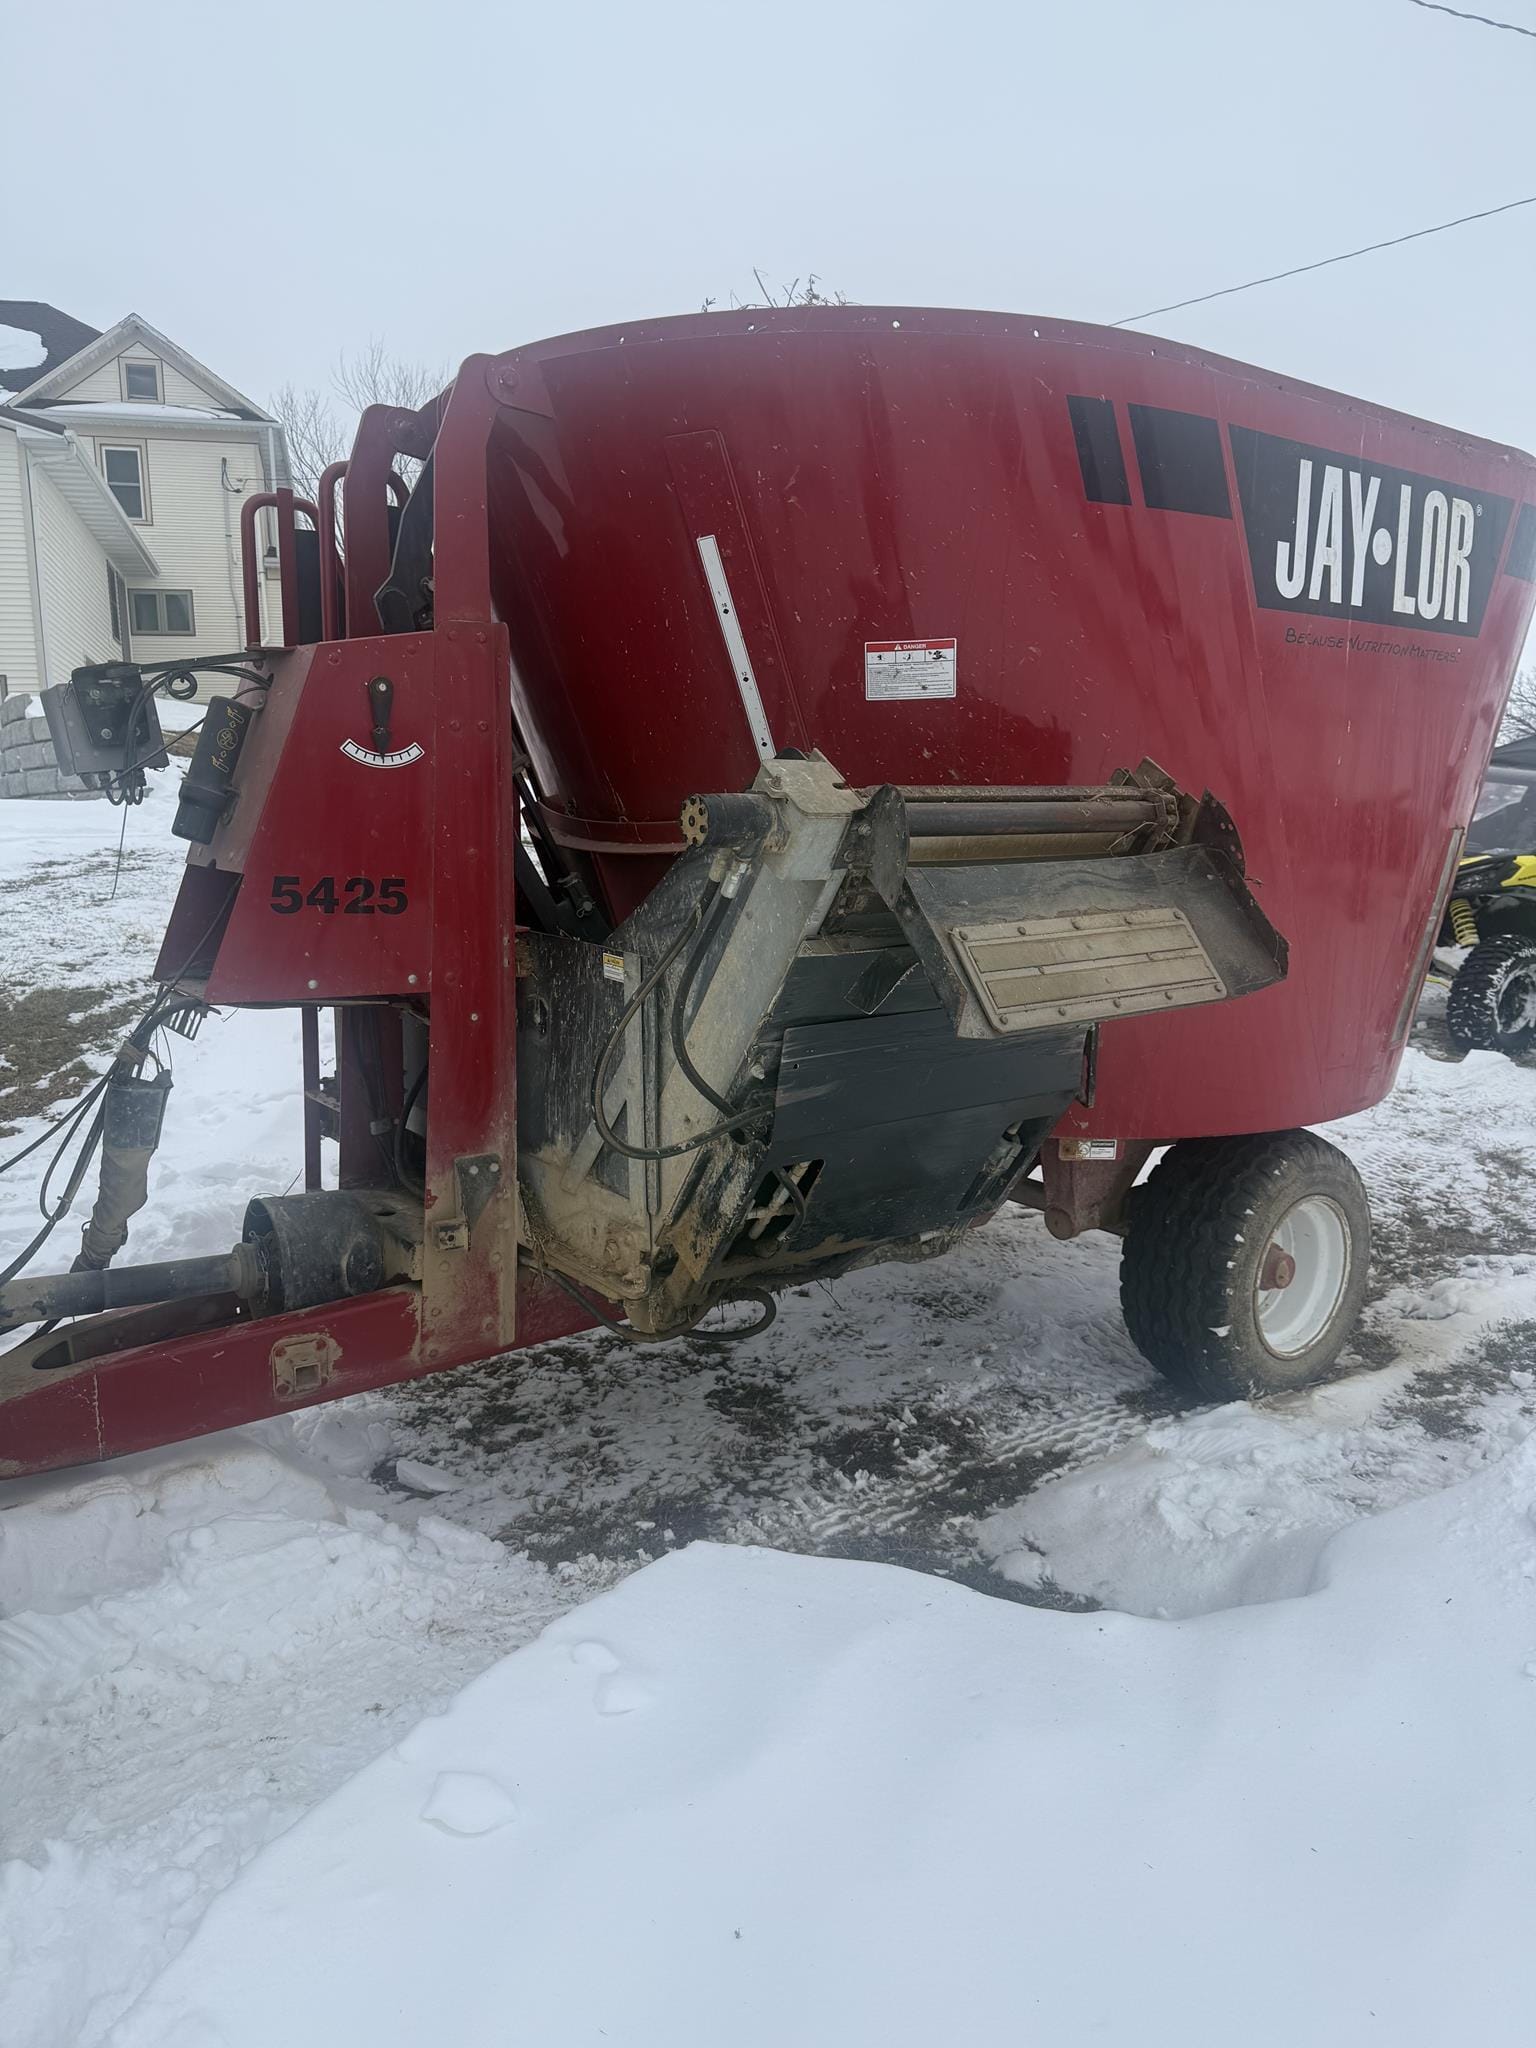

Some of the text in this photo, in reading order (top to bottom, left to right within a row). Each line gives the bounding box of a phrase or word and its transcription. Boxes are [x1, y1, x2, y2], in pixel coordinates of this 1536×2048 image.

[1285, 627, 1345, 649] BECAUSE
[1348, 633, 1410, 657] NUTRITION
[270, 875, 409, 915] 5425
